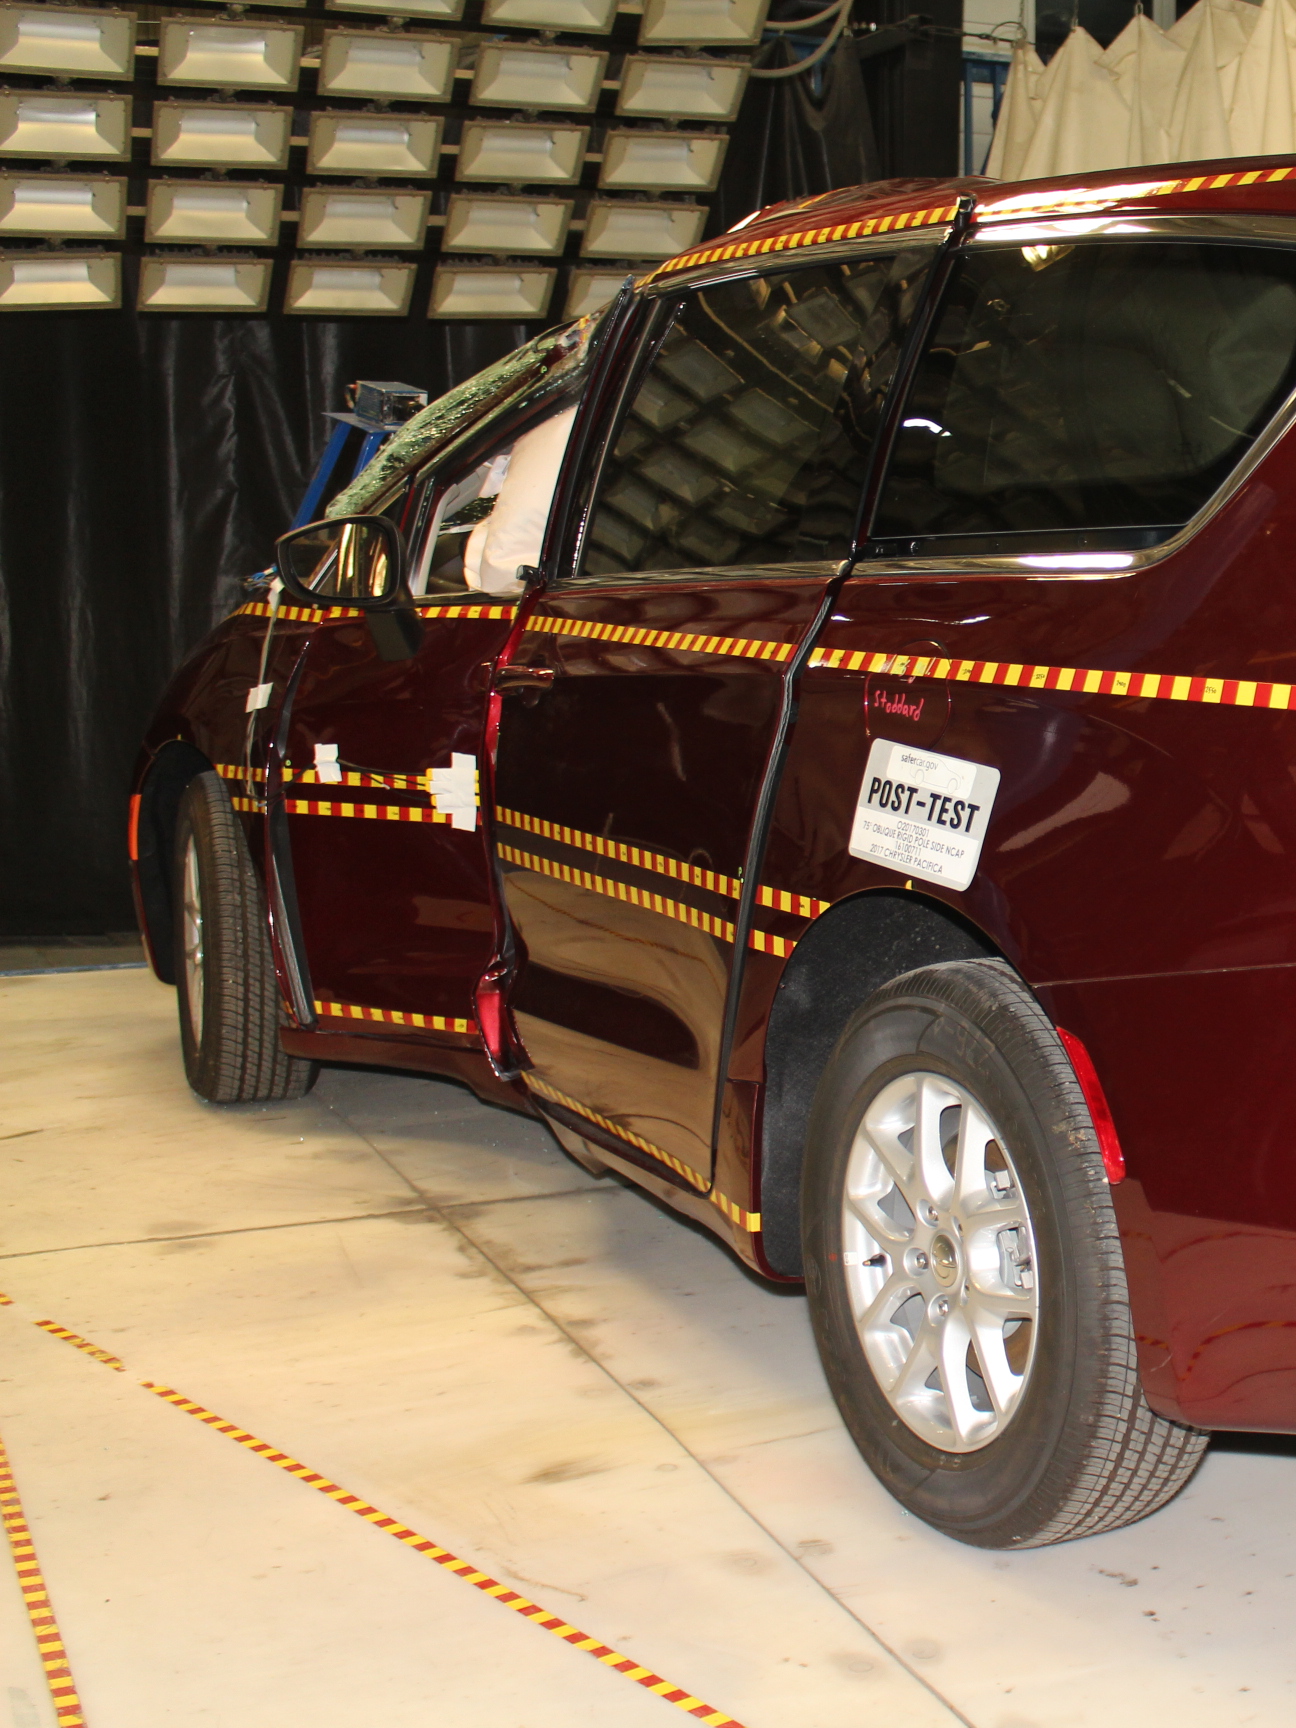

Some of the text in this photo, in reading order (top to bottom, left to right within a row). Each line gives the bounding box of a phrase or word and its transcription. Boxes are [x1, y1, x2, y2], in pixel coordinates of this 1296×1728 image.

[900, 753, 939, 771] safercar.gov
[867, 776, 981, 833] POST-TEST
[872, 823, 896, 839] OBLIQUE
[896, 831, 914, 845] RIGID
[914, 836, 930, 849] POLE
[930, 841, 945, 853] SIDE
[945, 845, 965, 858] NCAP
[869, 843, 943, 874] 2017 CHRYSLER PACIFICA
